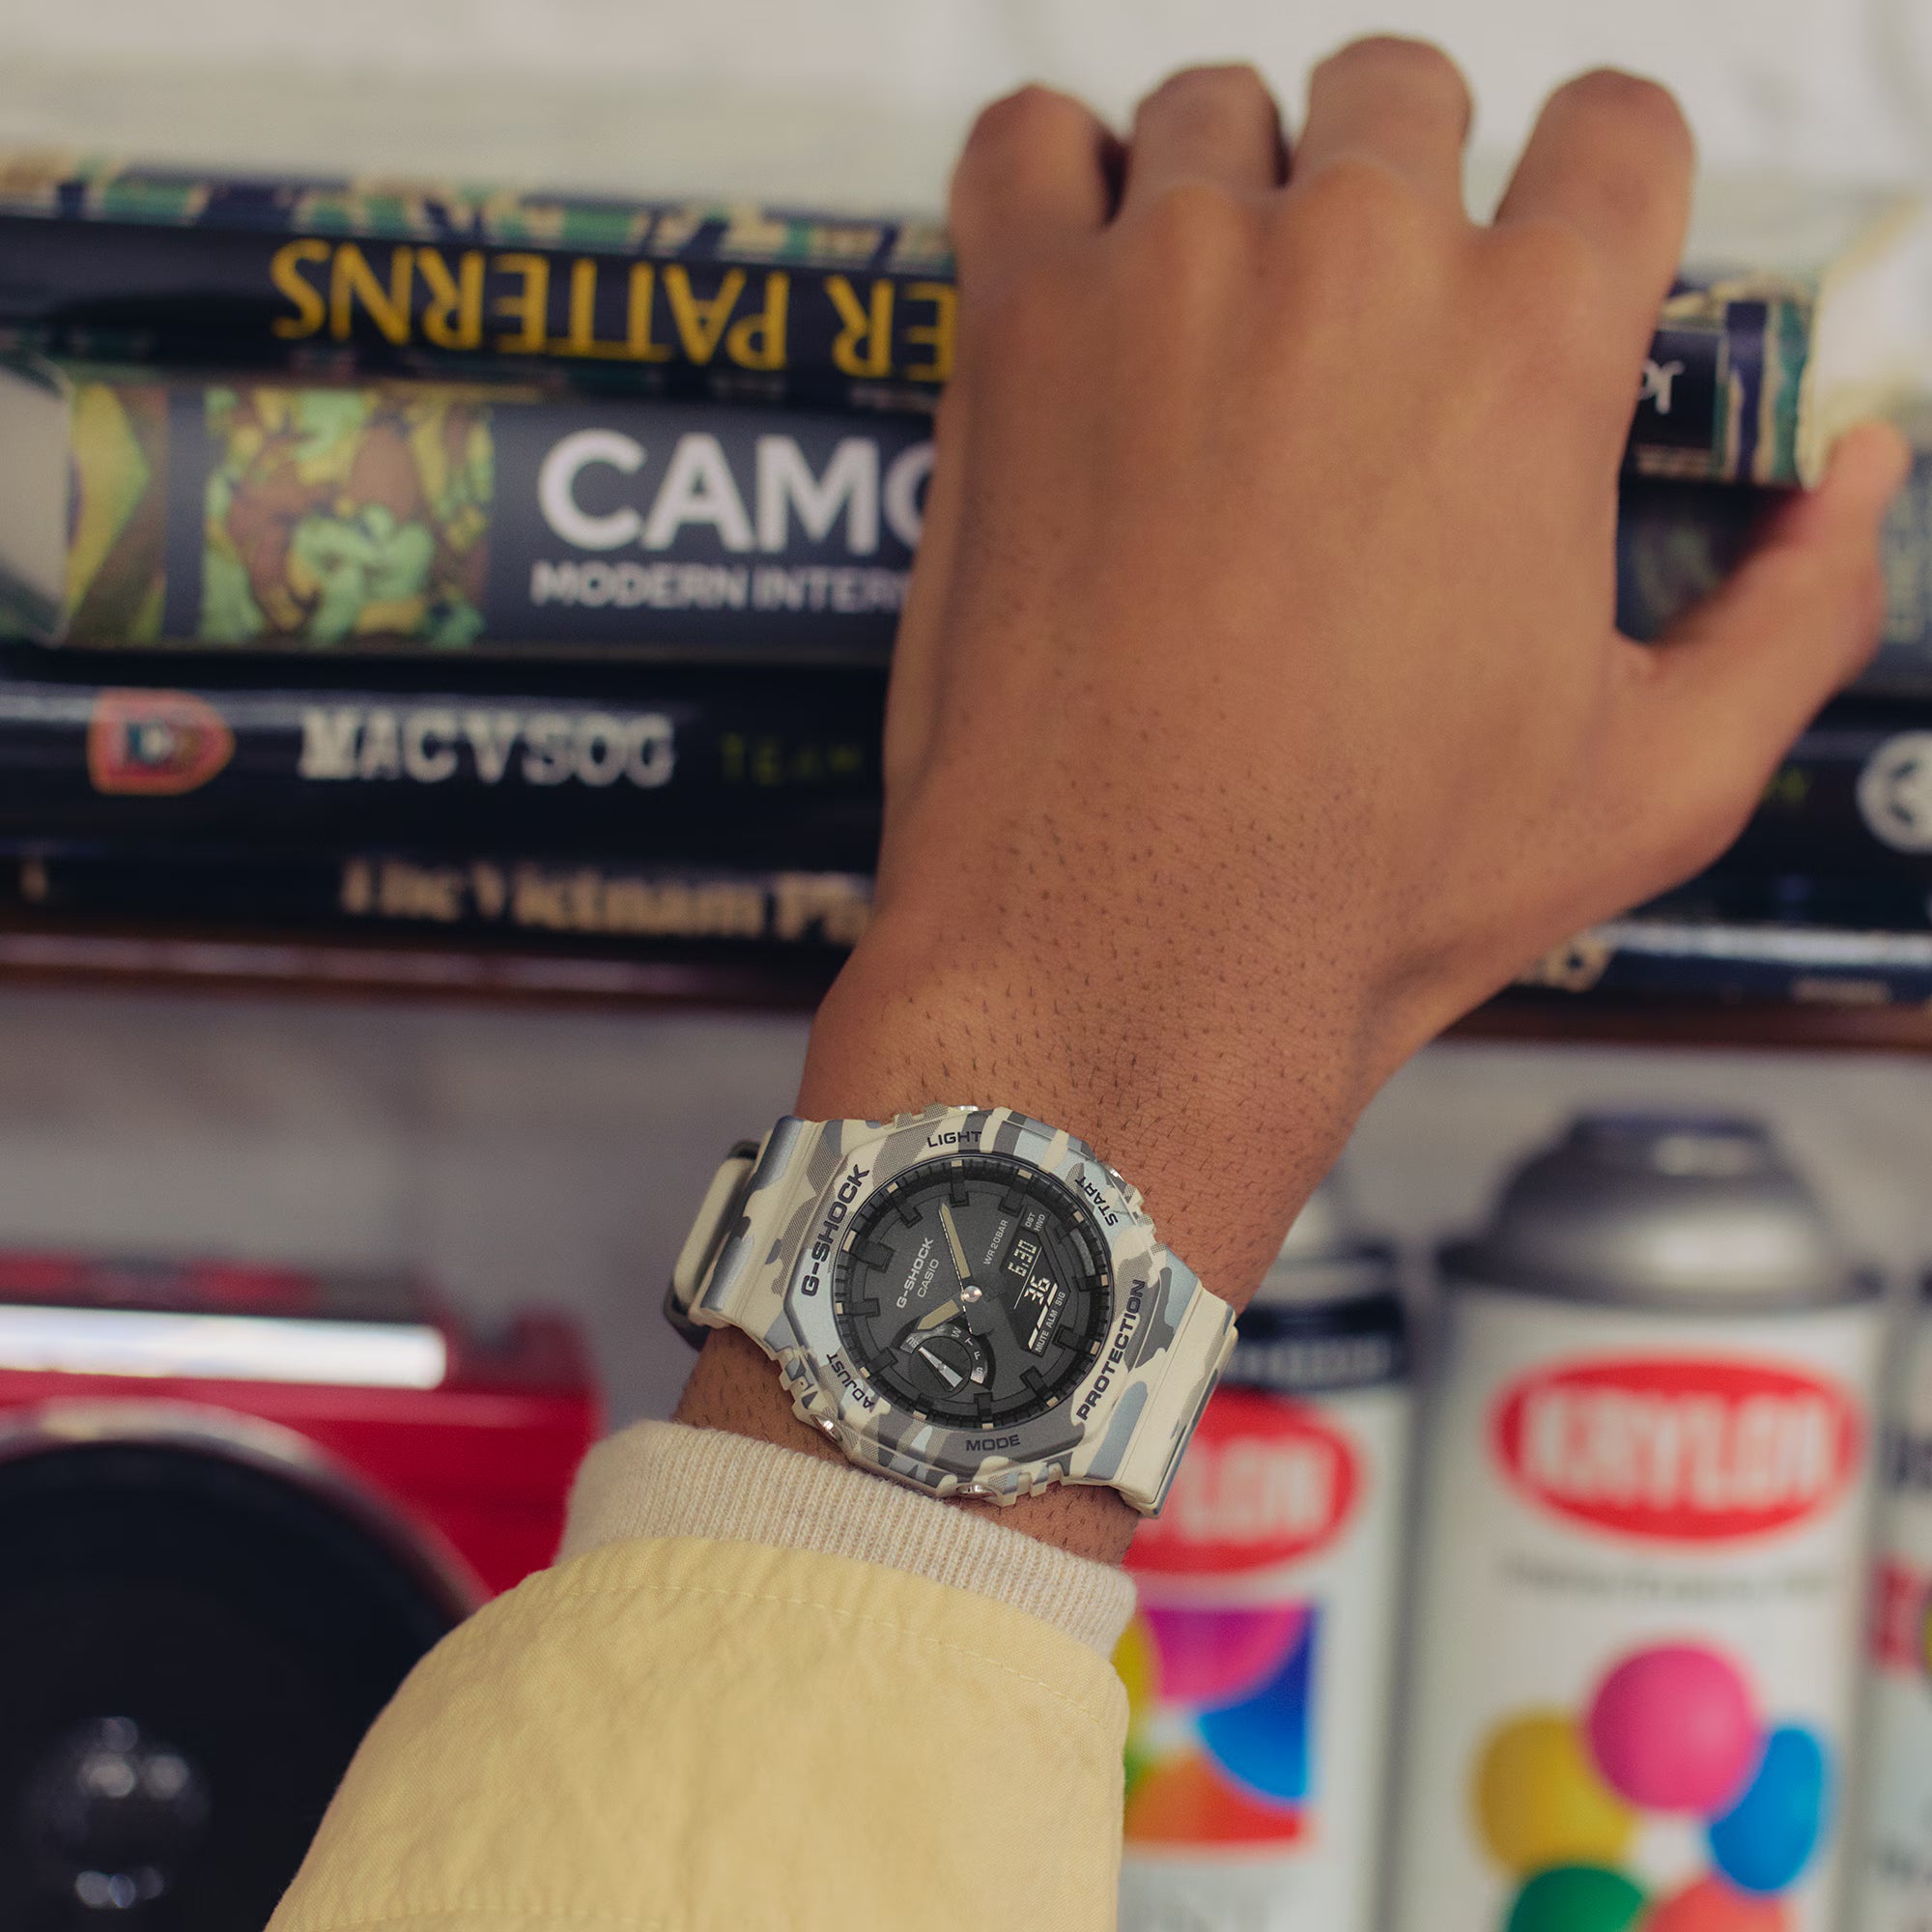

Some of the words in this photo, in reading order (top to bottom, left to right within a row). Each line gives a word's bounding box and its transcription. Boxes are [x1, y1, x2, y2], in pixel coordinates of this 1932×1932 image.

[270, 238, 789, 370] PATTERNS
[530, 560, 749, 610] MODERN
[753, 565, 911, 612] INTER
[473, 860, 769, 939] Vietnam
[927, 1131, 981, 1148] LIGHT
[1024, 1211, 1036, 1228] DST
[1034, 1213, 1046, 1232] HND
[1075, 1177, 1119, 1227] START
[801, 1164, 870, 1296] G-SHOCK
[983, 1249, 995, 1265] WR
[991, 1219, 1009, 1249] 20BAR
[895, 1237, 934, 1309] G-SHOCK
[918, 1260, 939, 1298] CASIO
[1024, 1275, 1051, 1305] 36
[1035, 1330, 1049, 1352] MUTE
[1046, 1310, 1059, 1328] ALM
[1056, 1292, 1065, 1307] SIG
[1076, 1279, 1146, 1421] PROTECTION
[826, 1353, 874, 1409] ADJUST
[966, 1435, 1020, 1451] MODE
